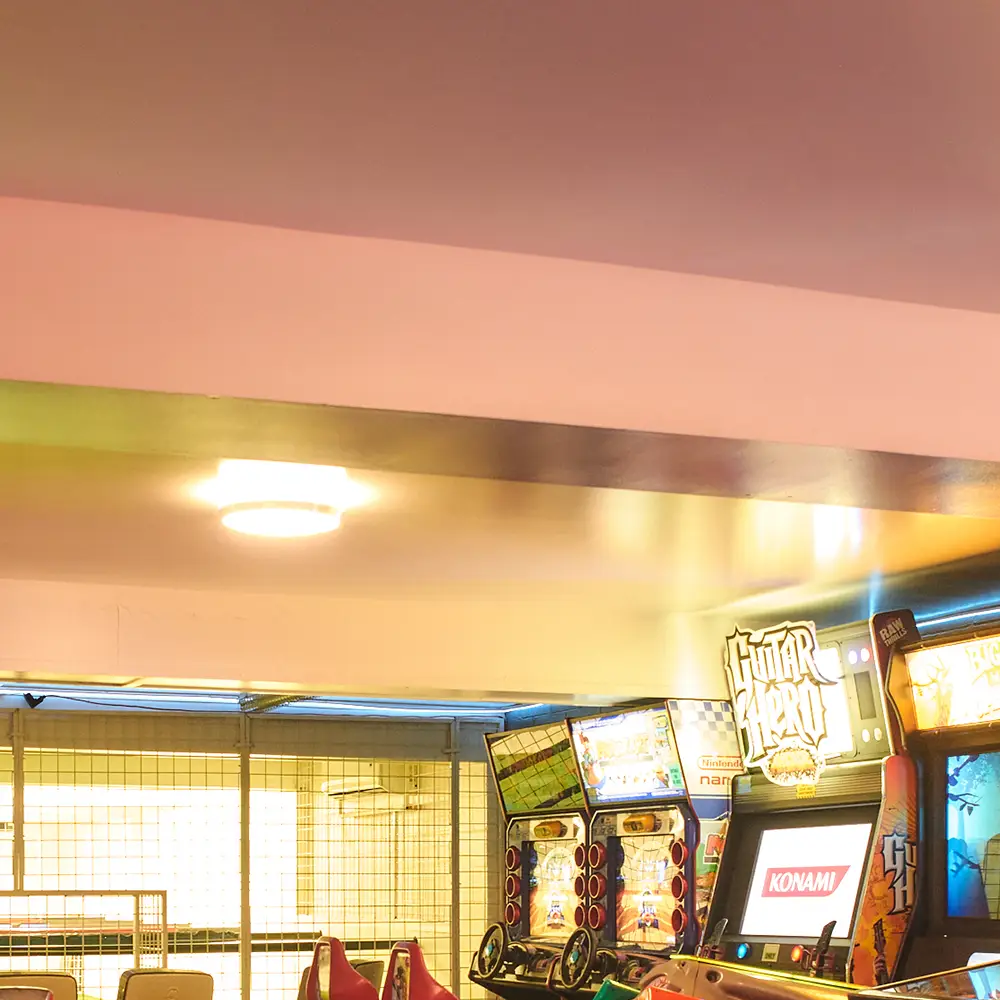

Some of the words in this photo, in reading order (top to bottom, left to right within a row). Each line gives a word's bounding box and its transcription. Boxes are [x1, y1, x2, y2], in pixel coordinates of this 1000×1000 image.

[880, 618, 904, 641] RAW
[726, 626, 832, 688] GUITAR
[736, 676, 826, 762] HERO
[769, 871, 835, 892] KONAMI
